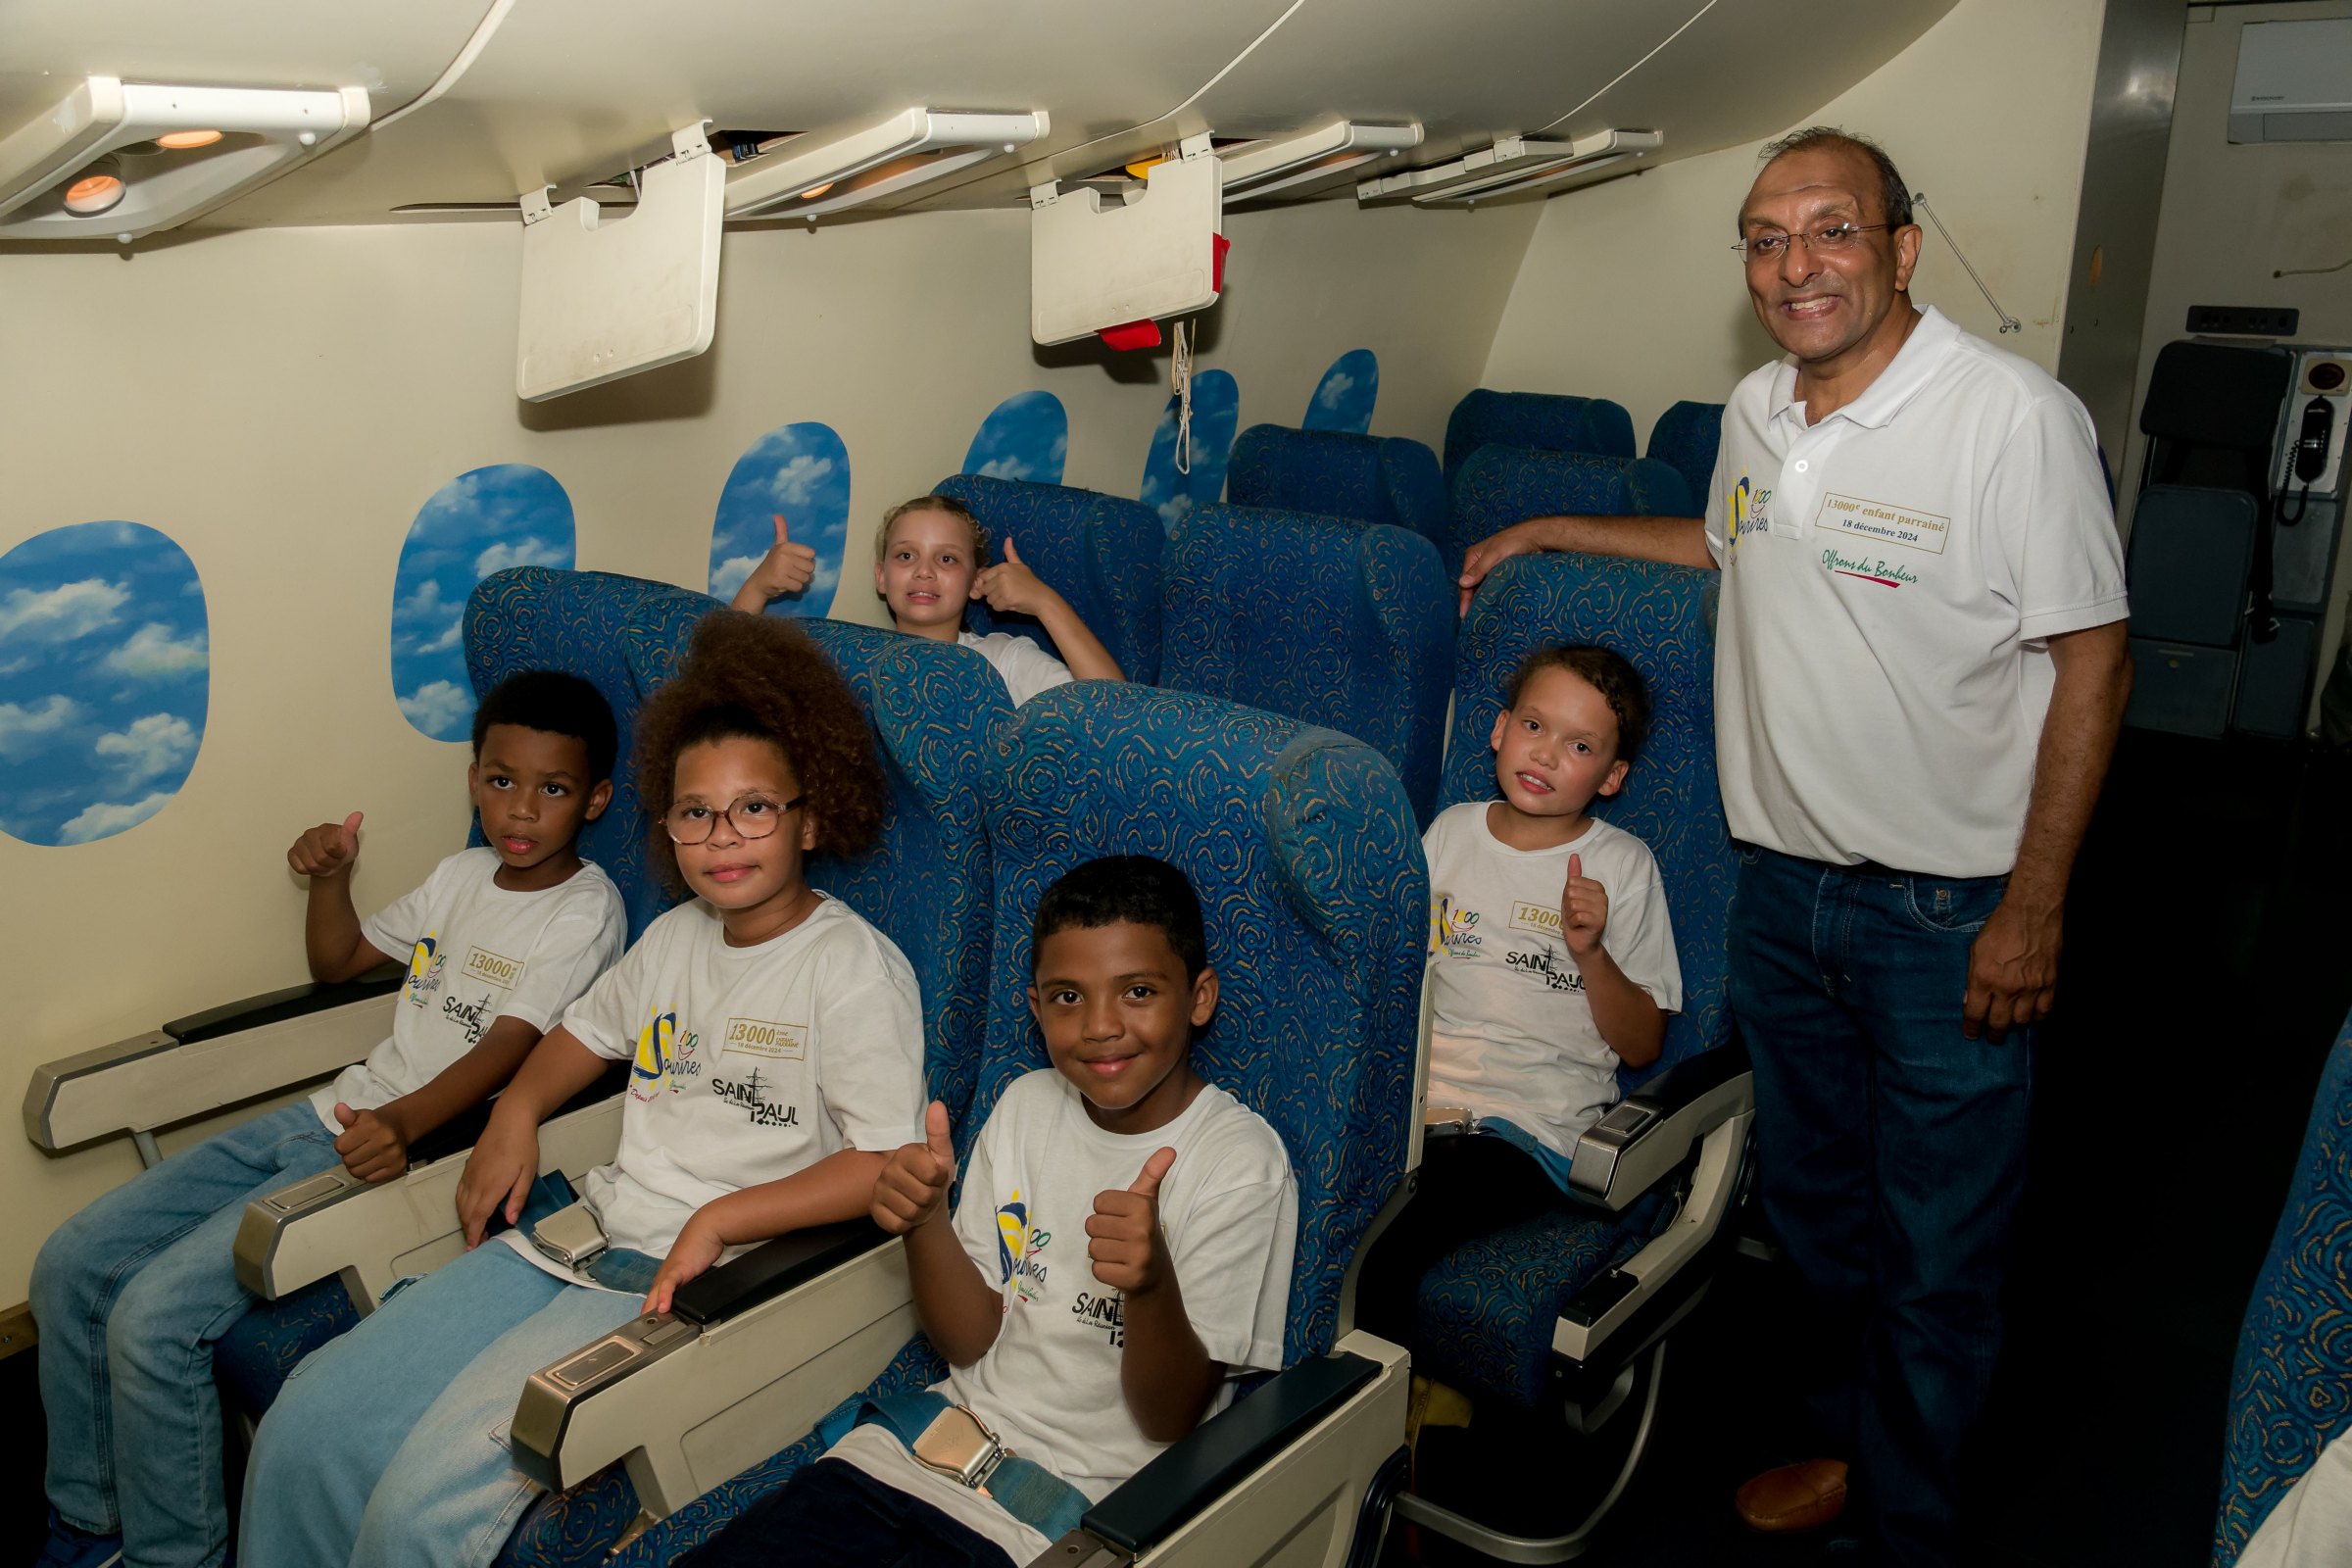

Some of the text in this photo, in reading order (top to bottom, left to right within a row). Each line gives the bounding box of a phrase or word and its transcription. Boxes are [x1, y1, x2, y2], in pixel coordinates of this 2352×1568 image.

[1842, 518, 1919, 542] 18 décembre 2024
[1862, 507, 1896, 521] enfant
[1896, 515, 1945, 532] parrainé
[1822, 549, 1919, 583] Offrons du Bonheur
[468, 953, 512, 978] 13000
[729, 1023, 775, 1046] 13000
[712, 1073, 770, 1106] SAINT
[751, 1103, 799, 1125] PAUL
